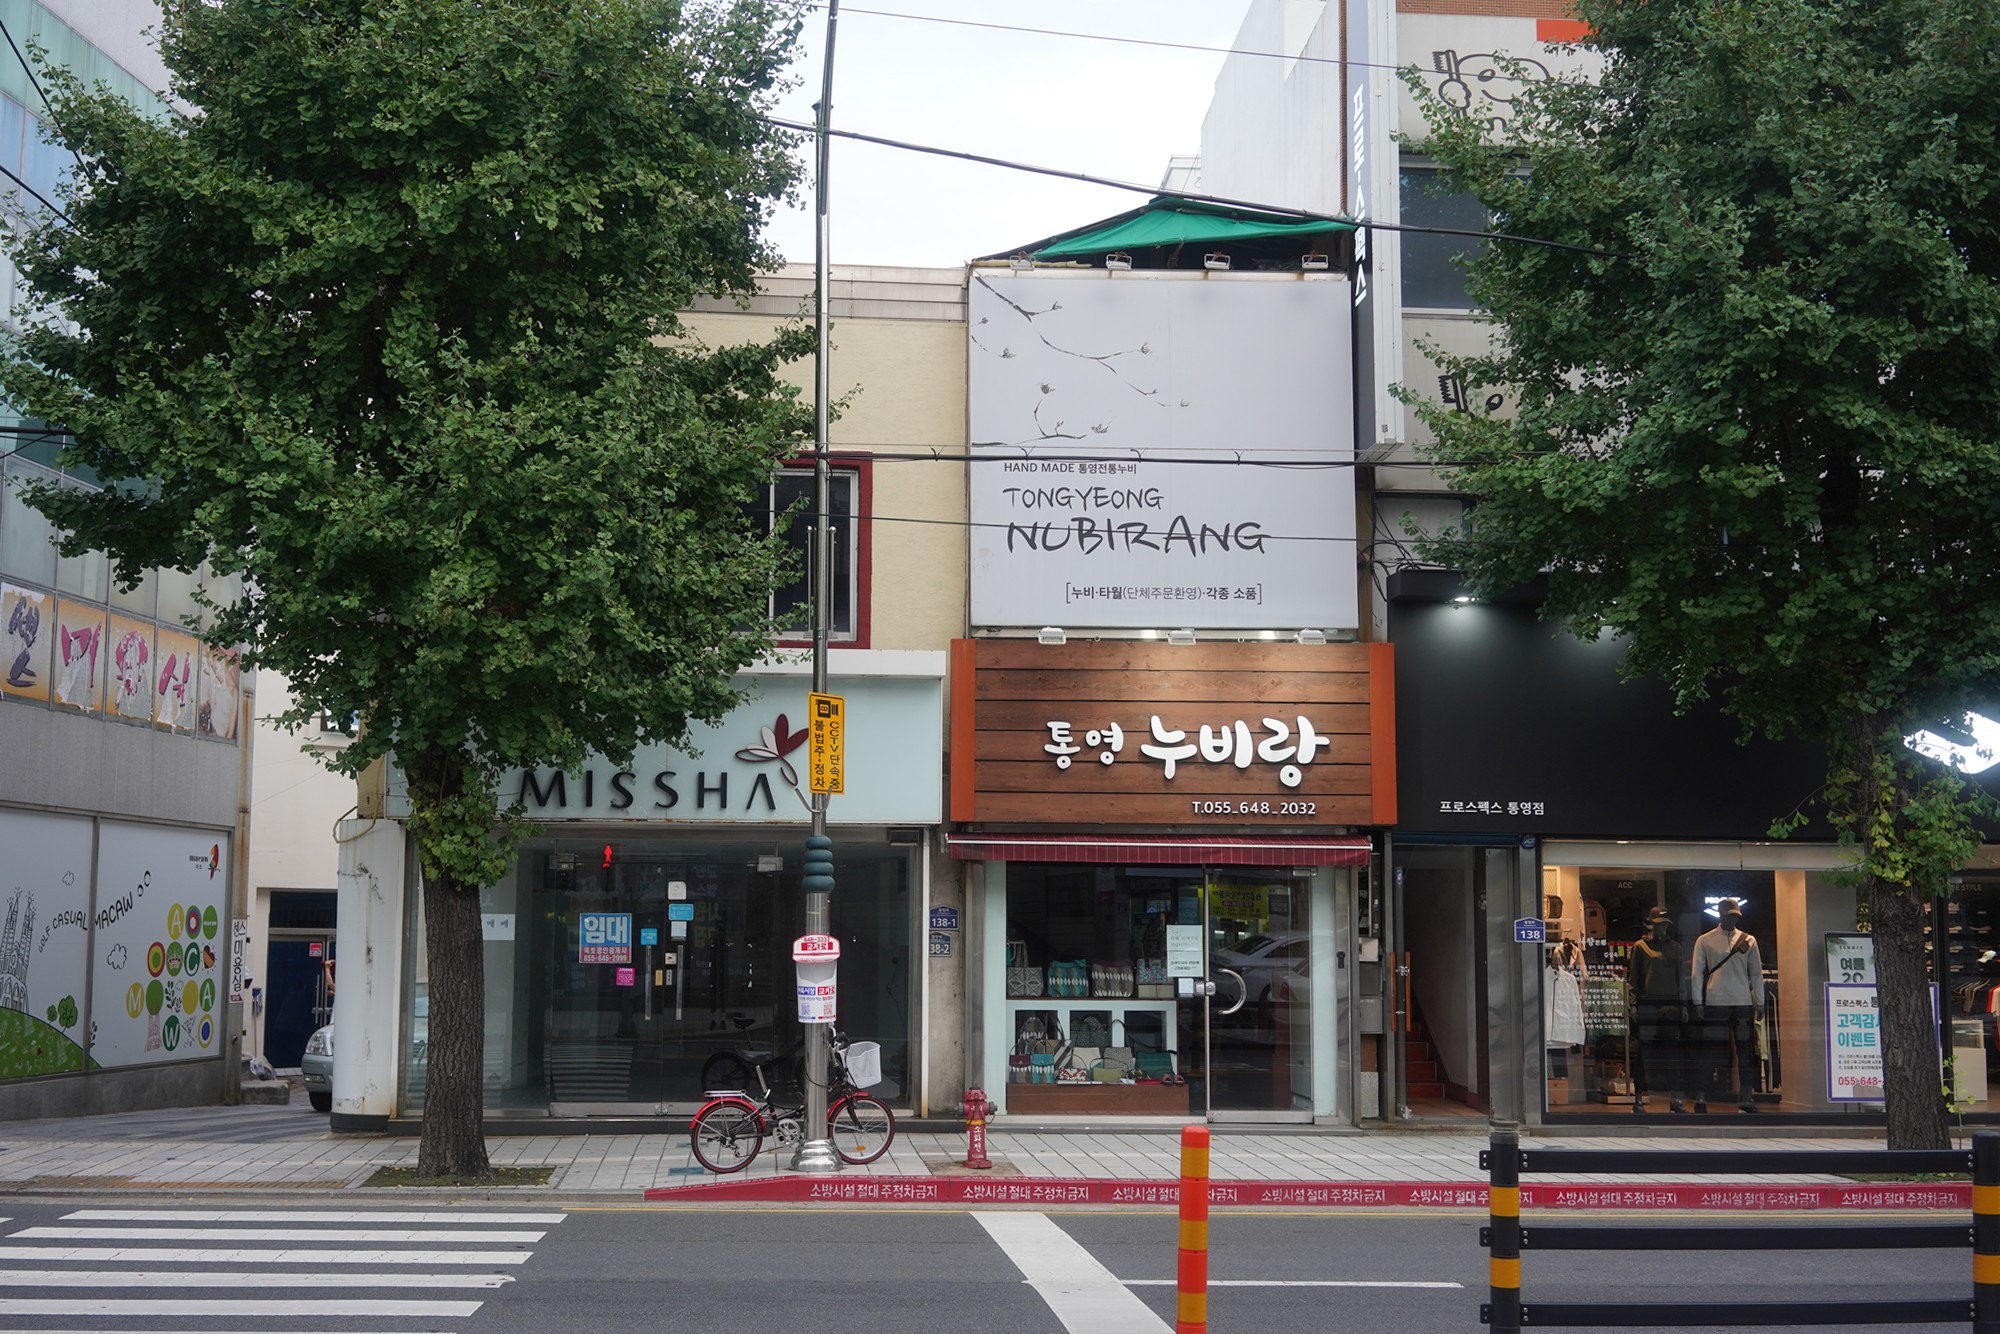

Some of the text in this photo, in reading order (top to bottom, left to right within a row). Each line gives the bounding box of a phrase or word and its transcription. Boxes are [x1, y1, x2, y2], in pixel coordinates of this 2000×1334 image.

[1004, 463, 1137, 475] HAND MADE 통영전통누비
[1002, 486, 1165, 511] TONGYEONG
[1007, 515, 1272, 557] NUBIRANG
[1044, 715, 1331, 787] 통영 누비랑
[519, 769, 776, 810] MISSHA
[1440, 801, 1545, 816] 프로스펙스 통영점
[1618, 881, 1633, 889] ACC
[52, 911, 88, 931] CASUAL
[94, 892, 133, 930] MACAW
[584, 916, 628, 943] 임대
[932, 918, 956, 927] 138-1
[1520, 930, 1541, 939] 138
[929, 944, 949, 954] 38-2
[231, 940, 243, 992] 미용실
[1840, 958, 1865, 971] 여름
[1836, 1000, 1869, 1008] 프로스펙스
[1838, 1032, 1876, 1047] 이벤트
[973, 1126, 982, 1153] 소화전
[810, 1183, 856, 1199] 소방시설
[857, 1183, 879, 1199] 절대
[963, 1186, 1007, 1200] 소방시설
[1009, 1186, 1031, 1200] 절대
[1112, 1186, 1157, 1201] 소방시설
[1158, 1186, 1180, 1201] 절대
[1261, 1188, 1306, 1203] 소방시설
[1307, 1188, 1329, 1203] 절대
[1410, 1188, 1453, 1203] 소방시설
[1454, 1189, 1476, 1204] 절대
[1556, 1189, 1599, 1205] 소방시설
[1600, 1189, 1621, 1205] 절대
